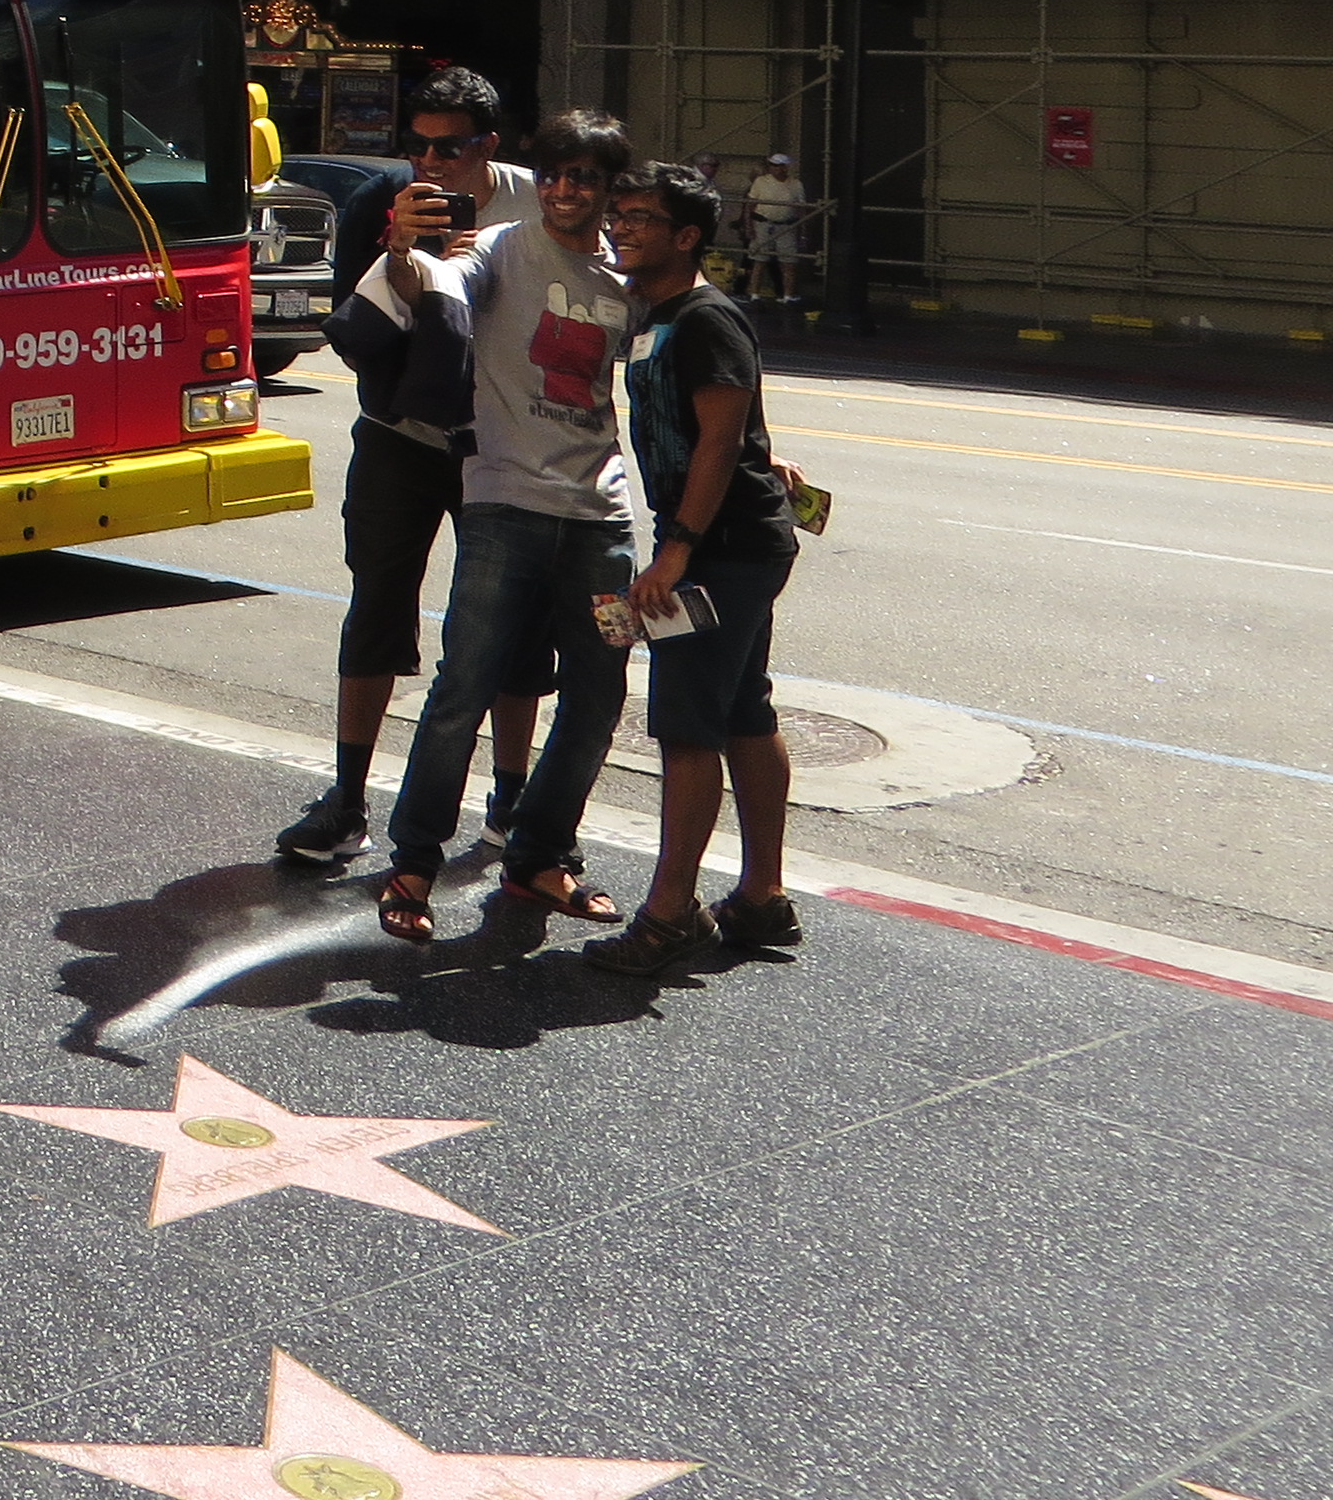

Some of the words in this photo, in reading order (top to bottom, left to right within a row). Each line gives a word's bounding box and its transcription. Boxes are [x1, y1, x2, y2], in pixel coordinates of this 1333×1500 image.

[15, 412, 71, 439] 93317E1
[305, 1122, 412, 1155] STEVEN
[167, 1150, 310, 1198] SPIELBERG
